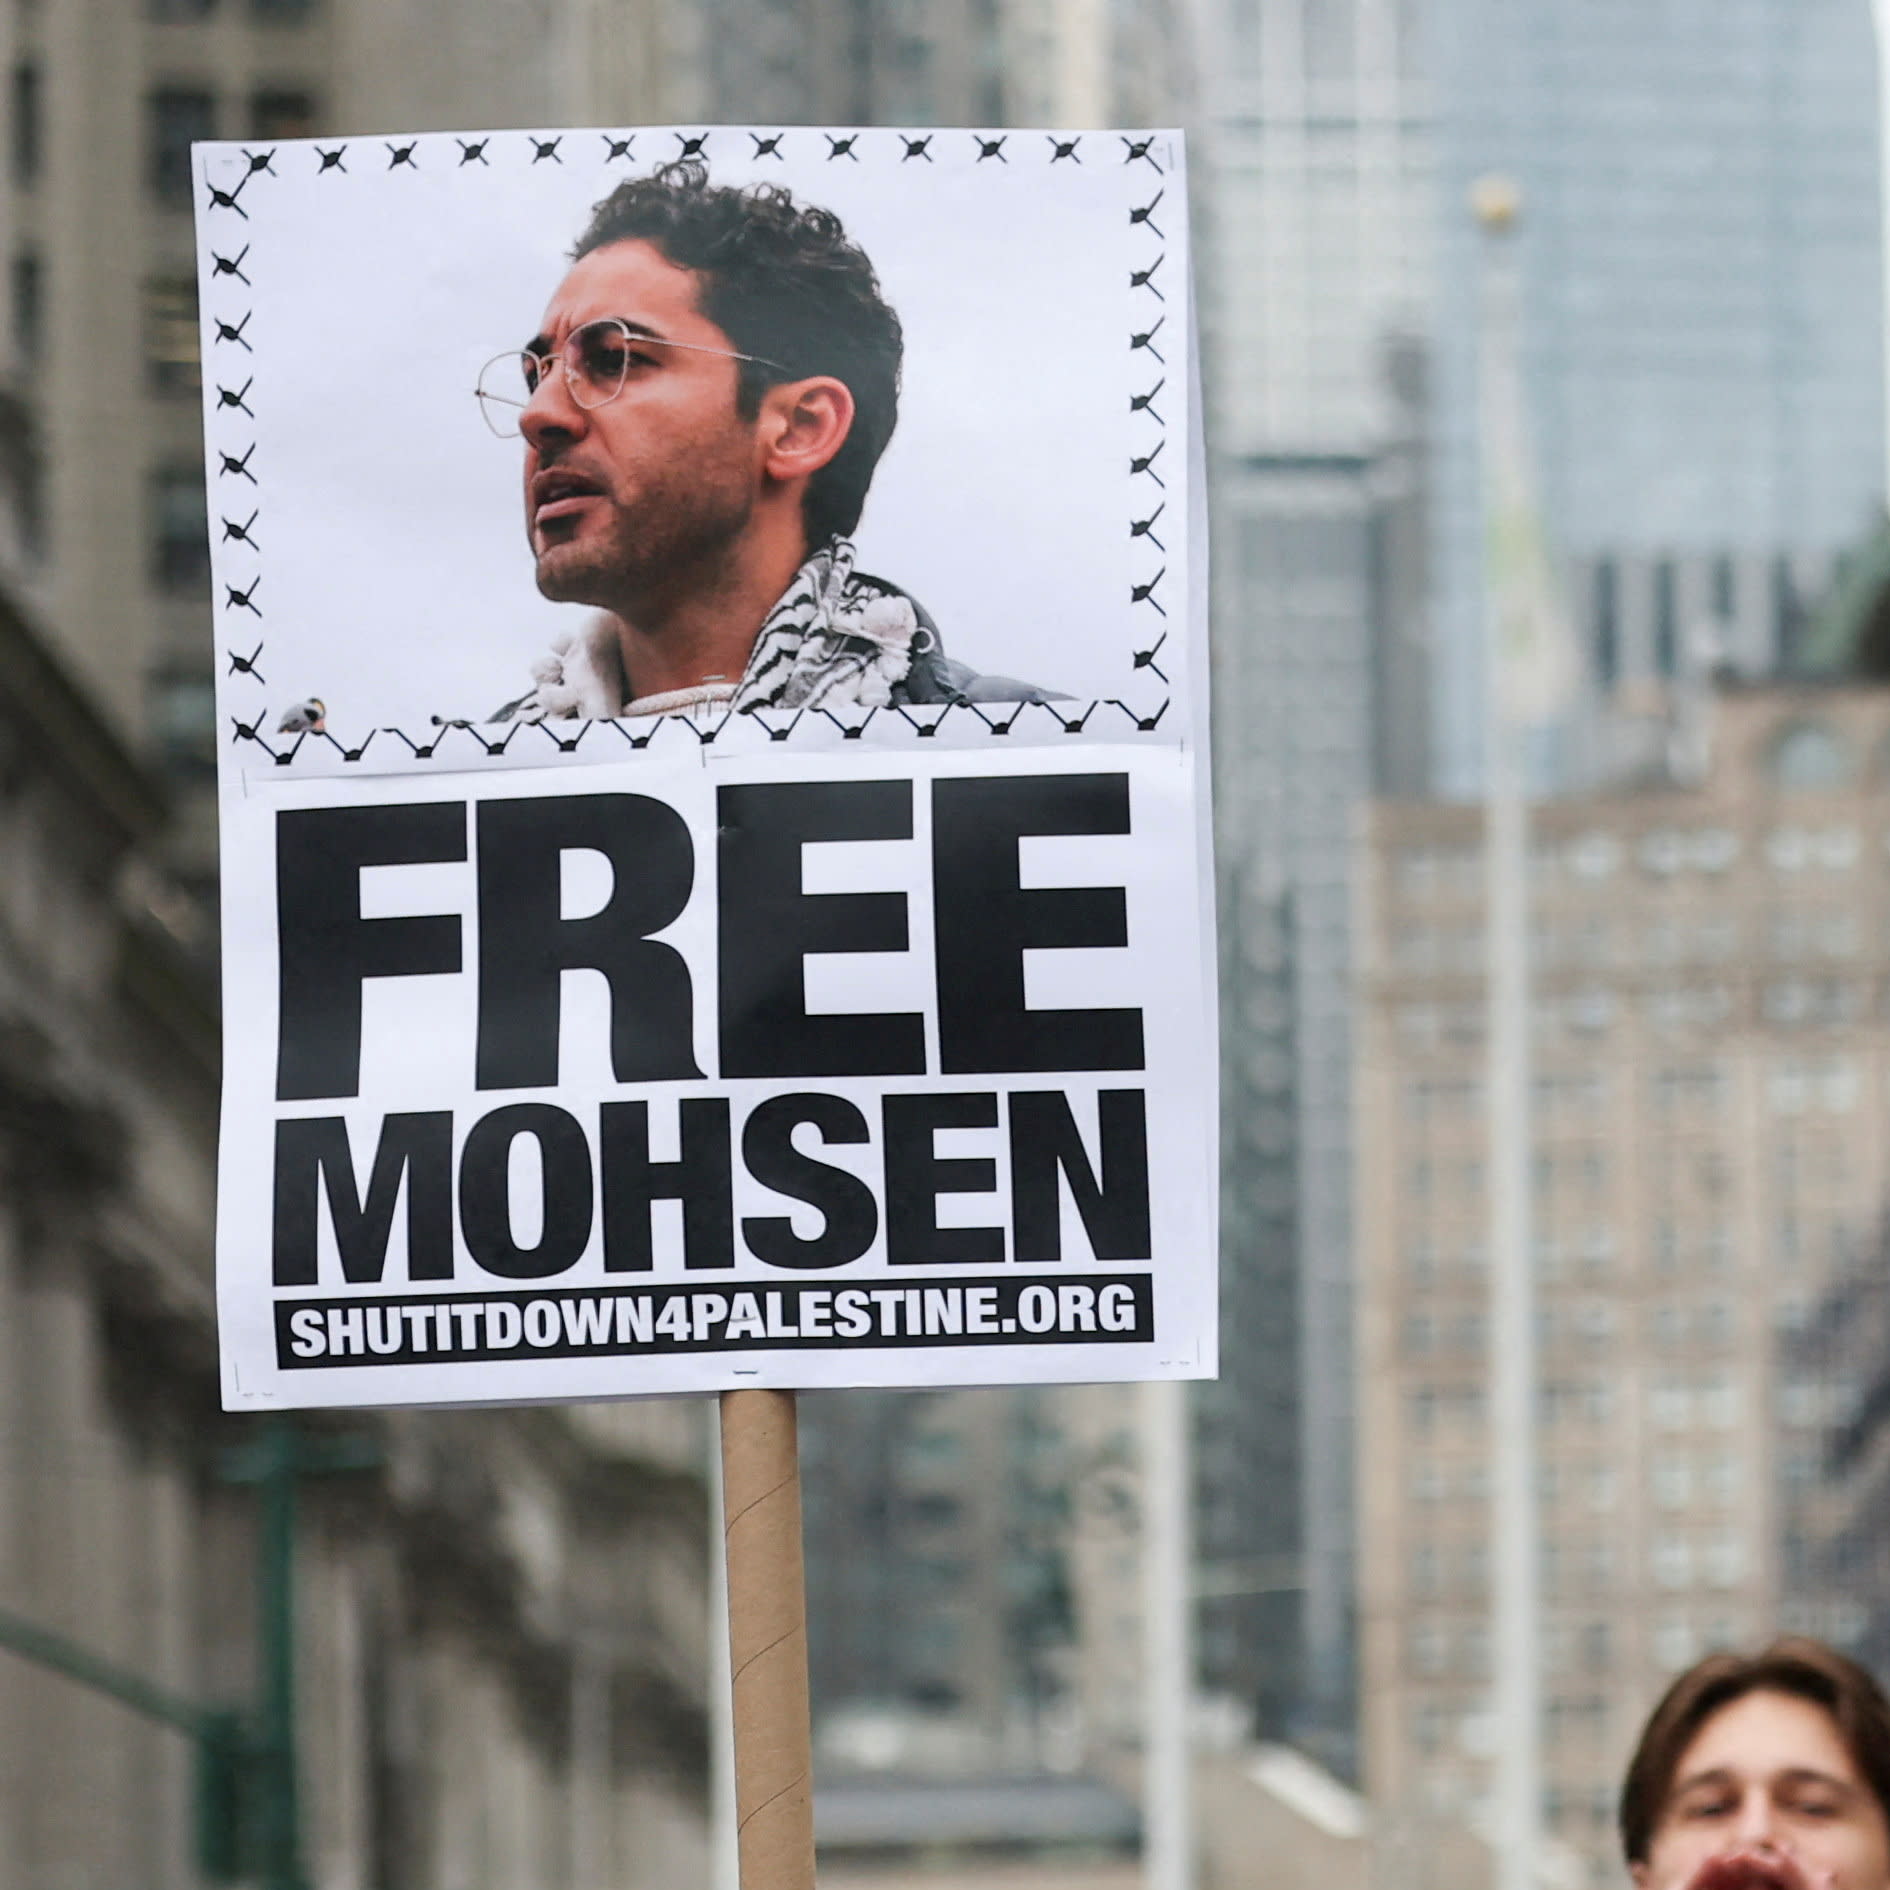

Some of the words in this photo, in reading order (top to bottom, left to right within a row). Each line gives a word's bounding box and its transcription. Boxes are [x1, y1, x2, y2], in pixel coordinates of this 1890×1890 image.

[275, 772, 1146, 1102] FREE
[271, 1088, 1152, 1287] MOHSEN
[289, 1284, 1137, 1358] SHUTITDOWN4PALESTINE.ORG
